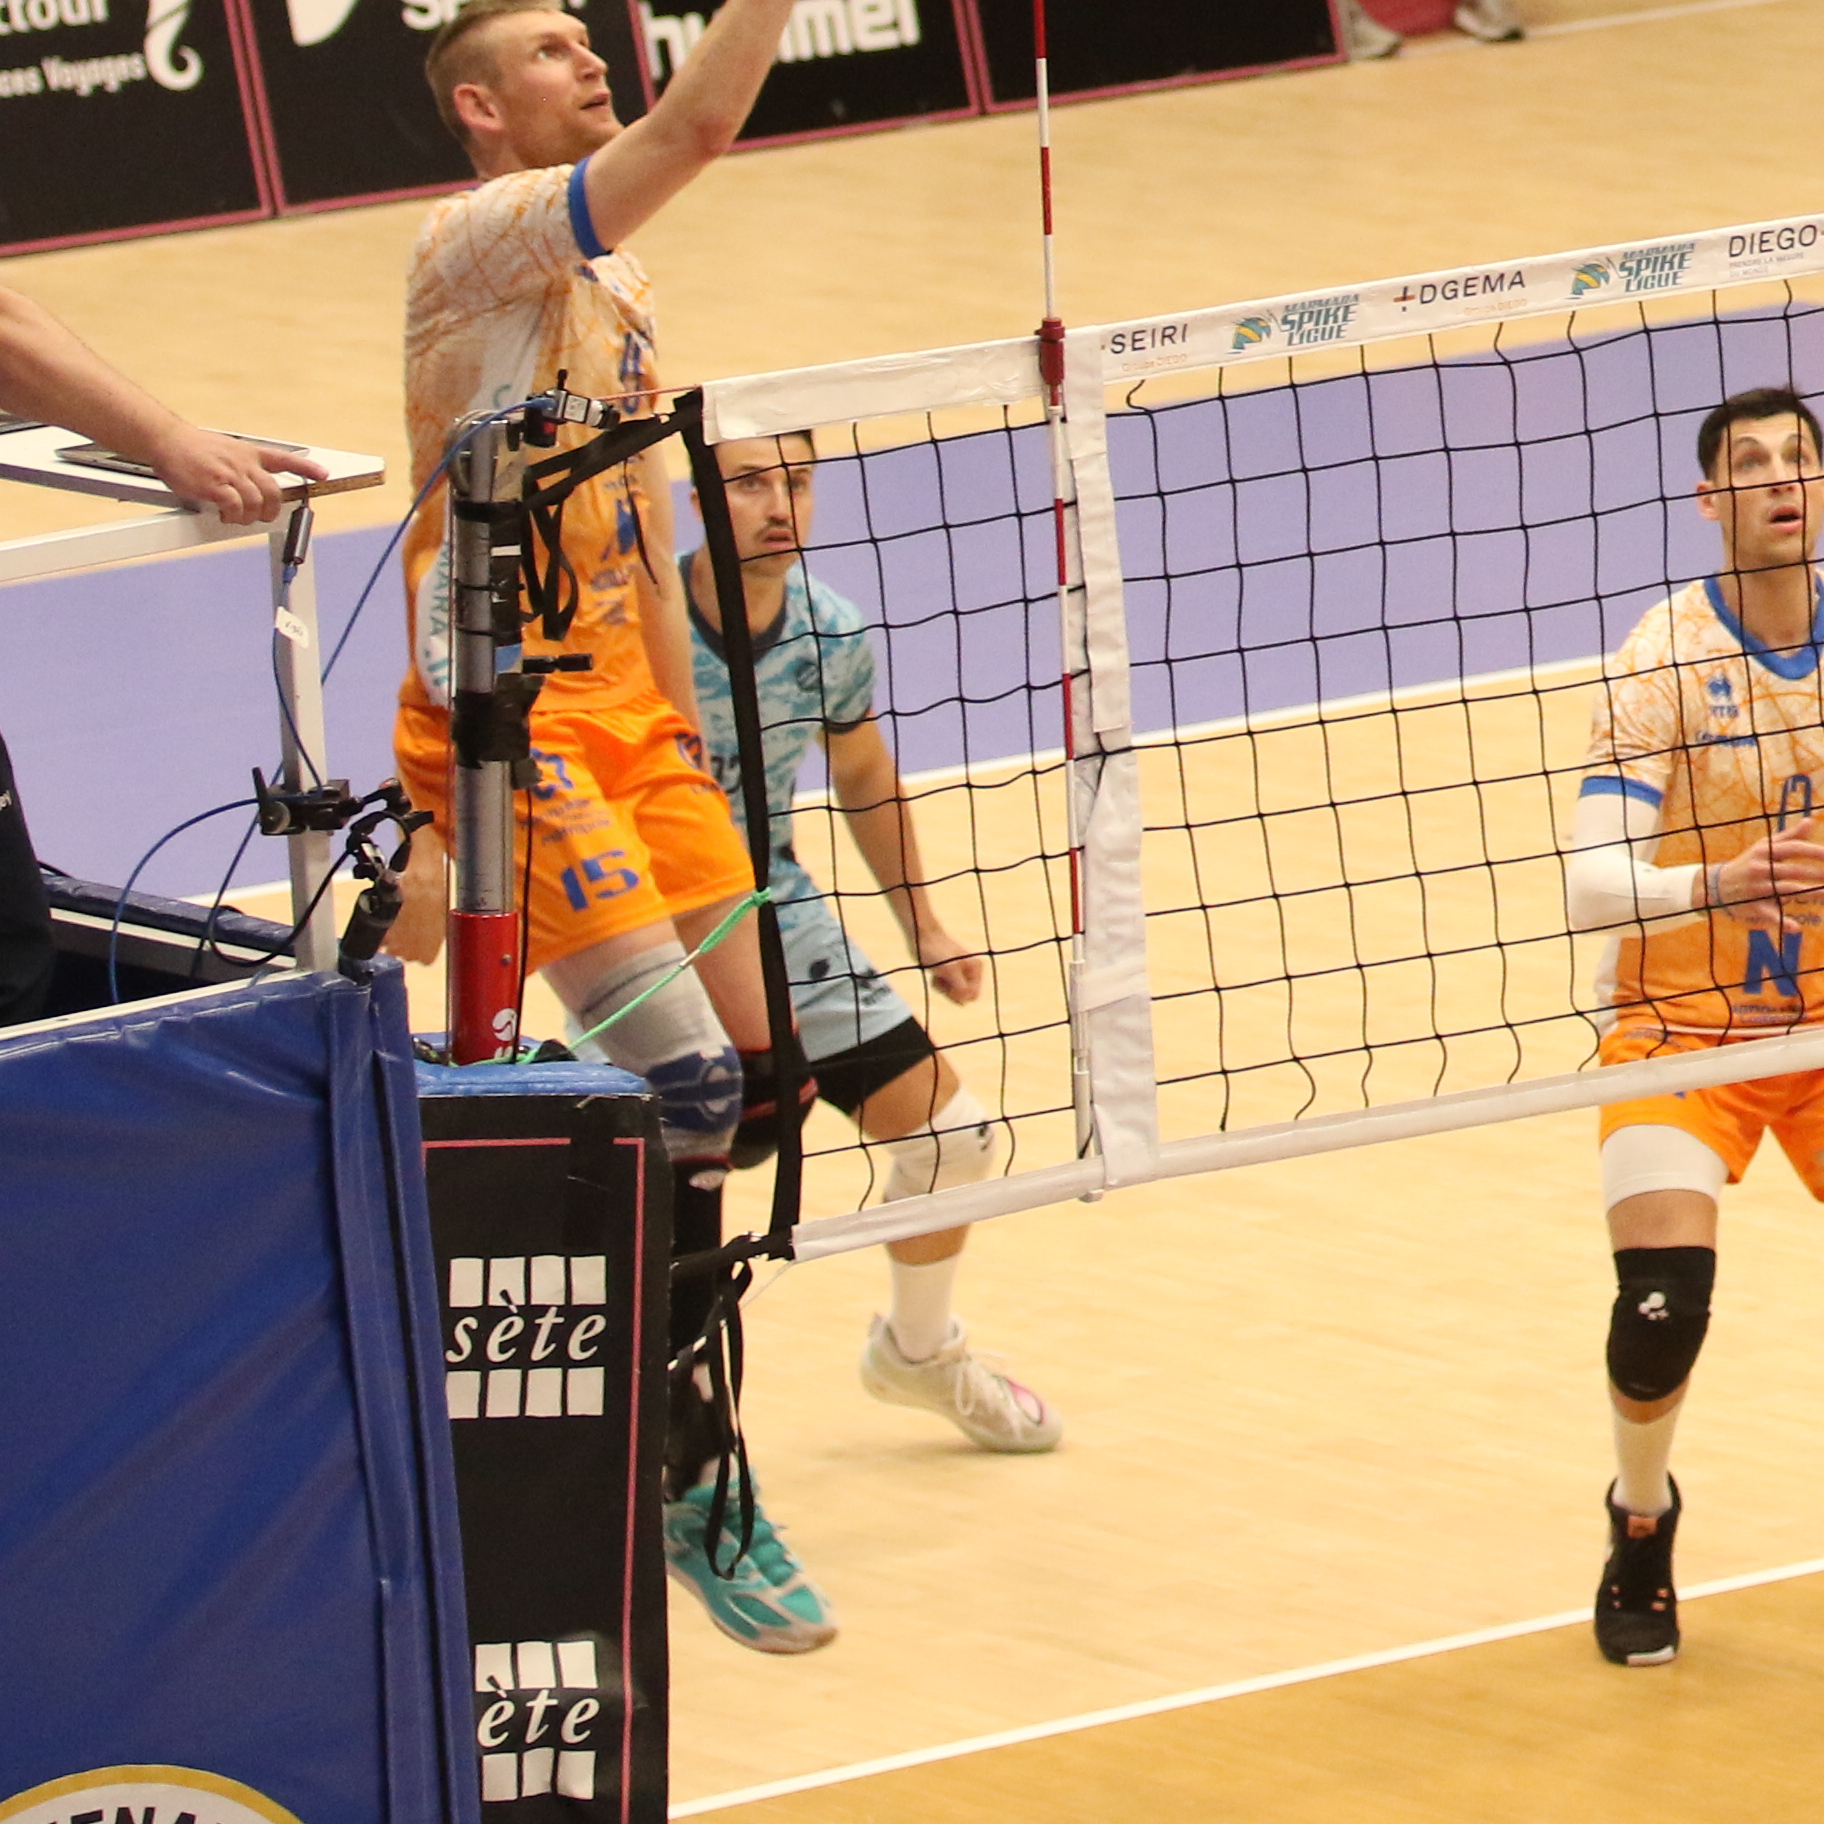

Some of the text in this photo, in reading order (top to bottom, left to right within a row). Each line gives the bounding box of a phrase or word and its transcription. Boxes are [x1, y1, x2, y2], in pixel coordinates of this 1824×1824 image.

[1728, 224, 1818, 259] DIEGO
[1618, 250, 1693, 279] SPIKE
[1419, 270, 1527, 305] DGEMA
[1624, 271, 1685, 294] LIGUE
[1279, 303, 1360, 334] SPIKE
[1286, 324, 1349, 347] LIGUE
[1109, 323, 1188, 355] SEIRI
[560, 849, 640, 912] 15
[1743, 928, 1804, 997] N
[446, 1289, 607, 1364] sète
[476, 1675, 601, 1749] ète
